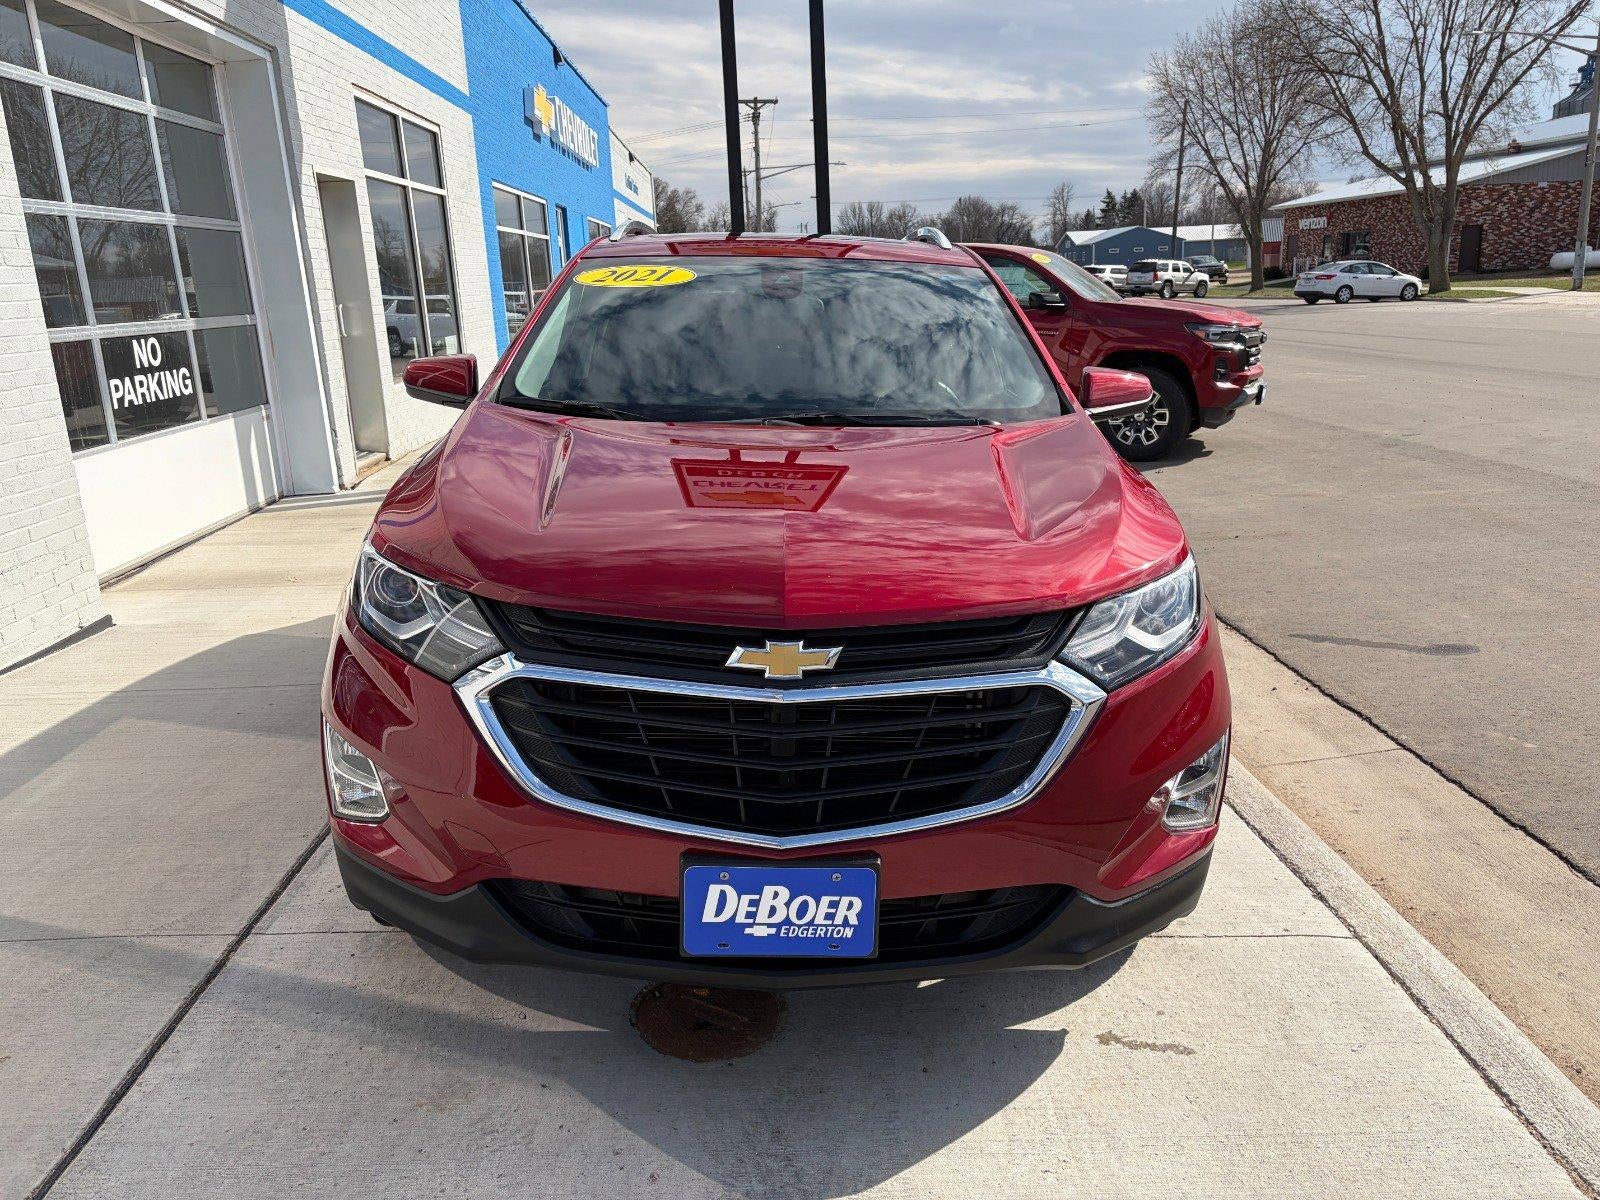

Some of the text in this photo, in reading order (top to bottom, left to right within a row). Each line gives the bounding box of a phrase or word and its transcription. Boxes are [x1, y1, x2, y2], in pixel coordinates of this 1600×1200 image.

[554, 96, 599, 168] CHEVROLET
[1299, 214, 1328, 230] verizon
[591, 269, 675, 282] 2021
[132, 337, 162, 369] NO
[109, 367, 193, 410] PARKING
[702, 884, 862, 925] DEBOER
[780, 926, 854, 938] EDGERTON
